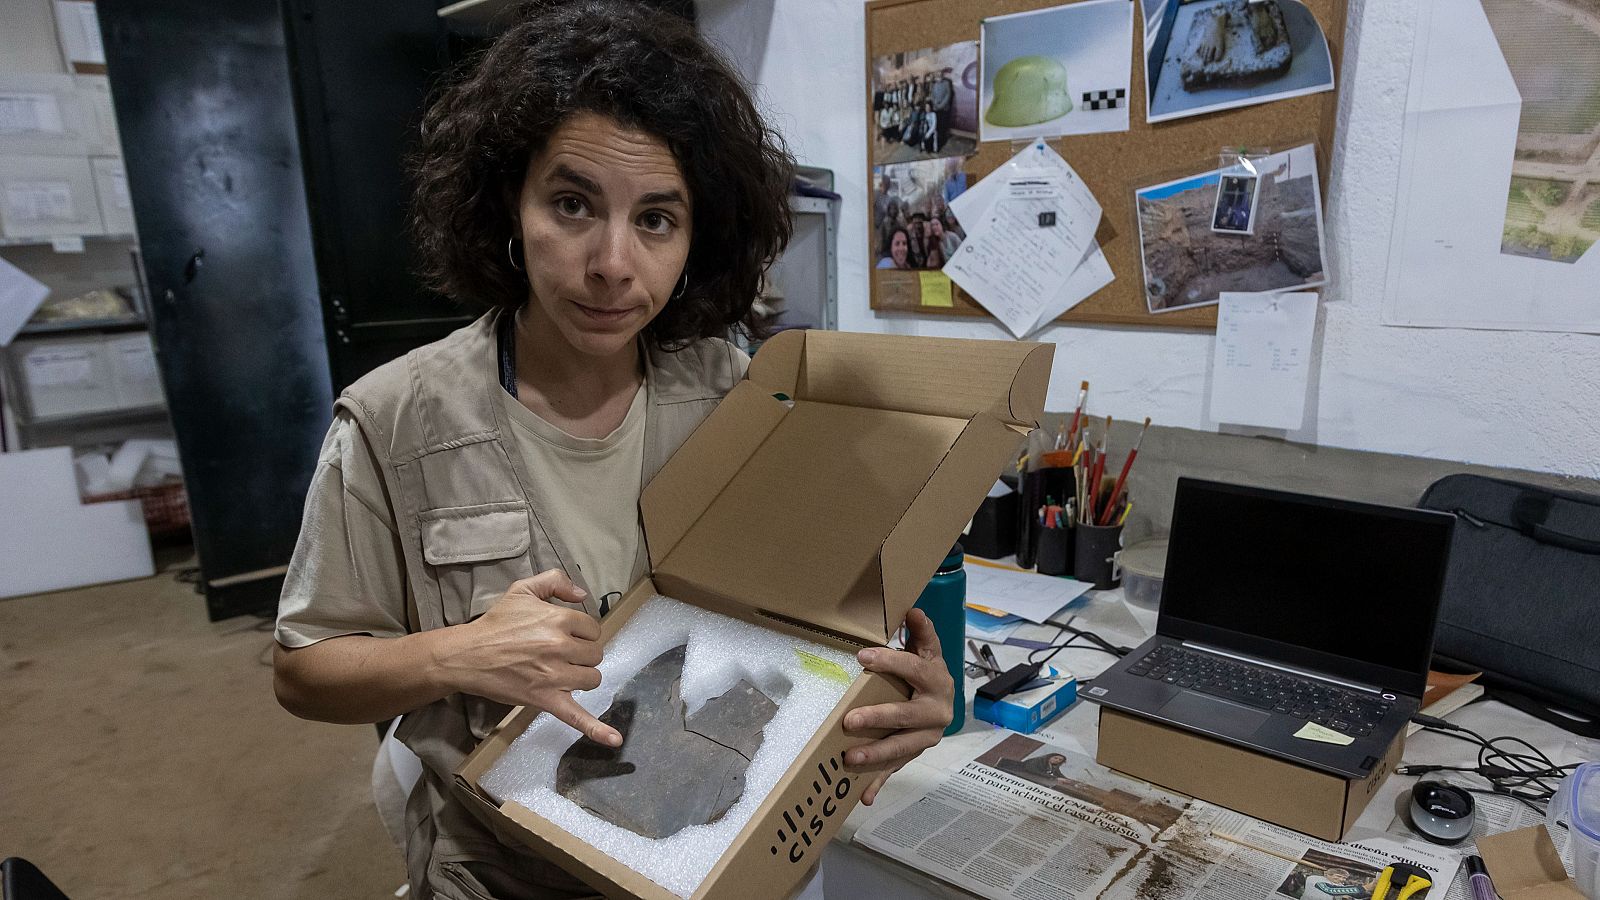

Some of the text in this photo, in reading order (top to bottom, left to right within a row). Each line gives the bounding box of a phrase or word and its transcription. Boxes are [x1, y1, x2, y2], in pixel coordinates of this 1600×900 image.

[789, 777, 851, 863] CISCO
[959, 768, 1141, 839] Junts para aclarar el caso Pegasus
[978, 767, 1025, 788] Gobierno
[1026, 785, 1051, 797] abre
[1053, 794, 1064, 802] el
[1097, 810, 1123, 822] ERC
[1350, 843, 1389, 857] diseña
[1391, 854, 1440, 874] equipos
